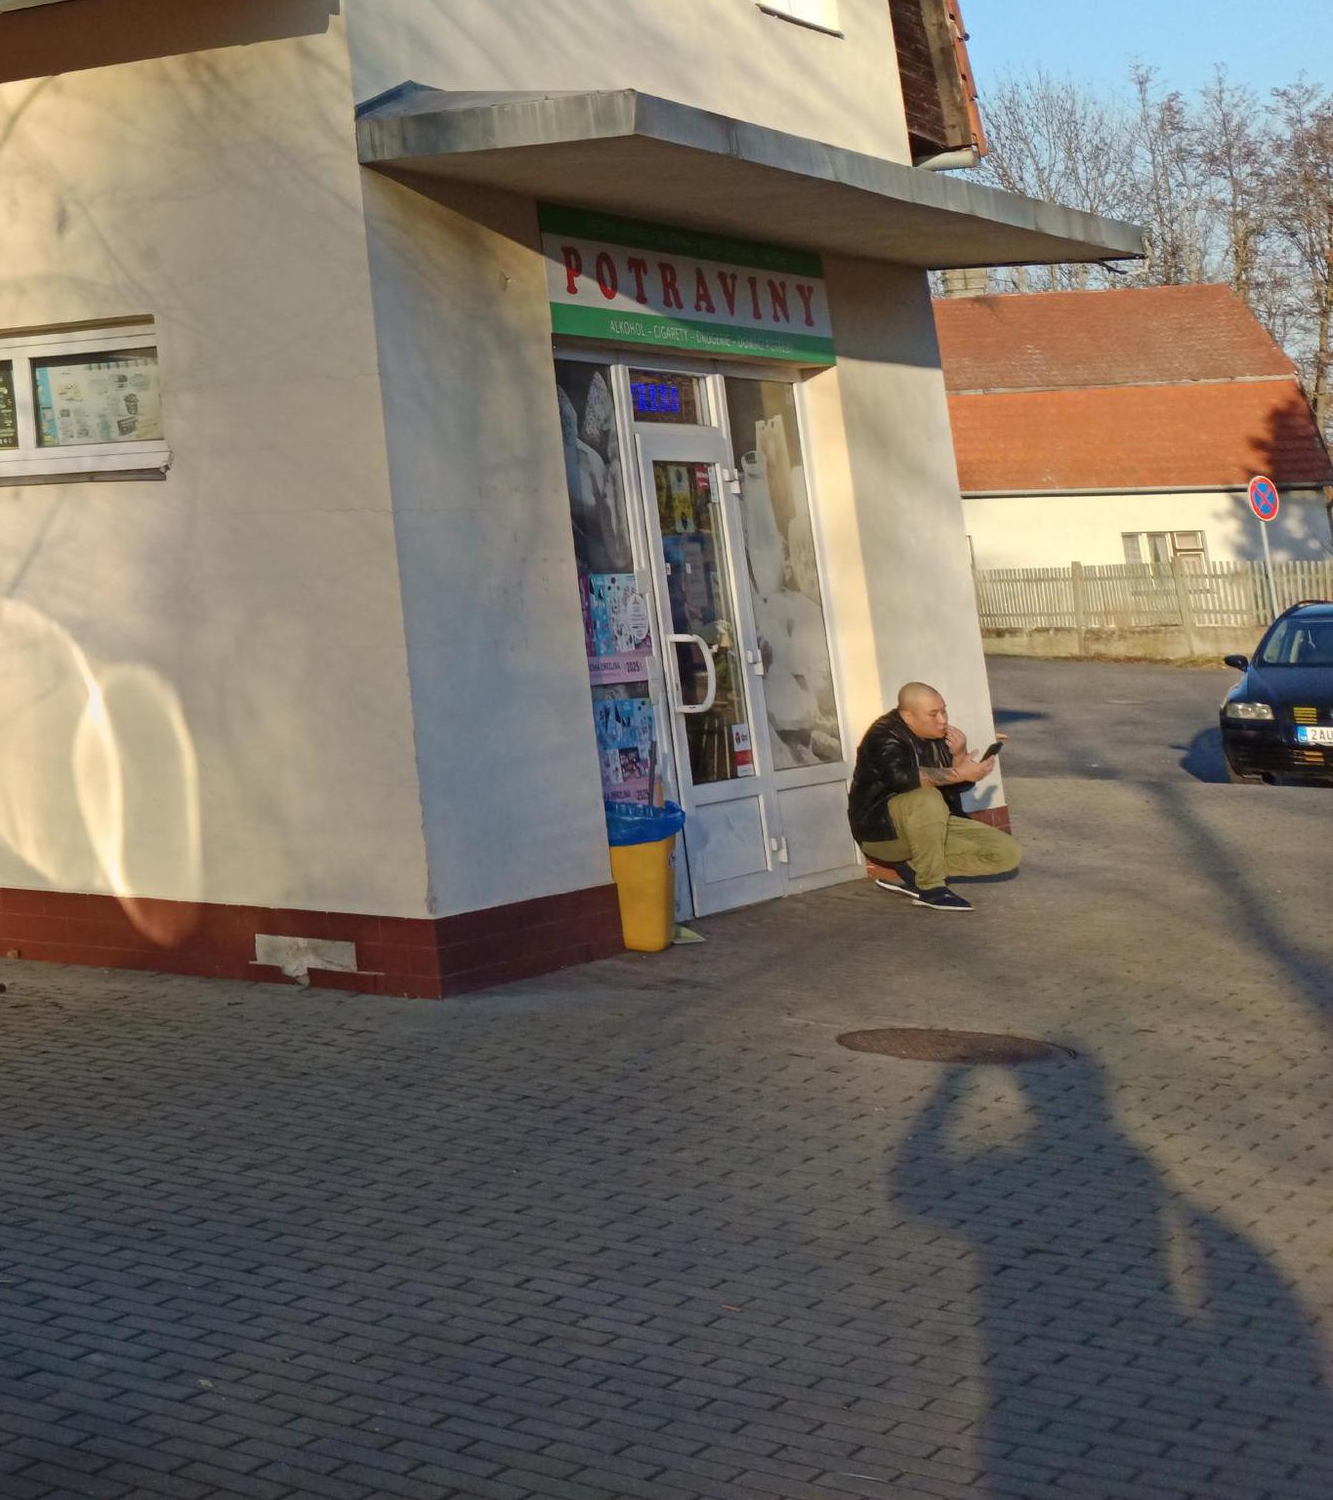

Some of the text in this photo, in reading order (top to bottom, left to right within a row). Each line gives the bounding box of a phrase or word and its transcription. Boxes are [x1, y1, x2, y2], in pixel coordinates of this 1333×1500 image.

[560, 245, 815, 327] POTRAVINY
[610, 320, 645, 337] ALKOHOL
[653, 324, 689, 342] CIGARETY
